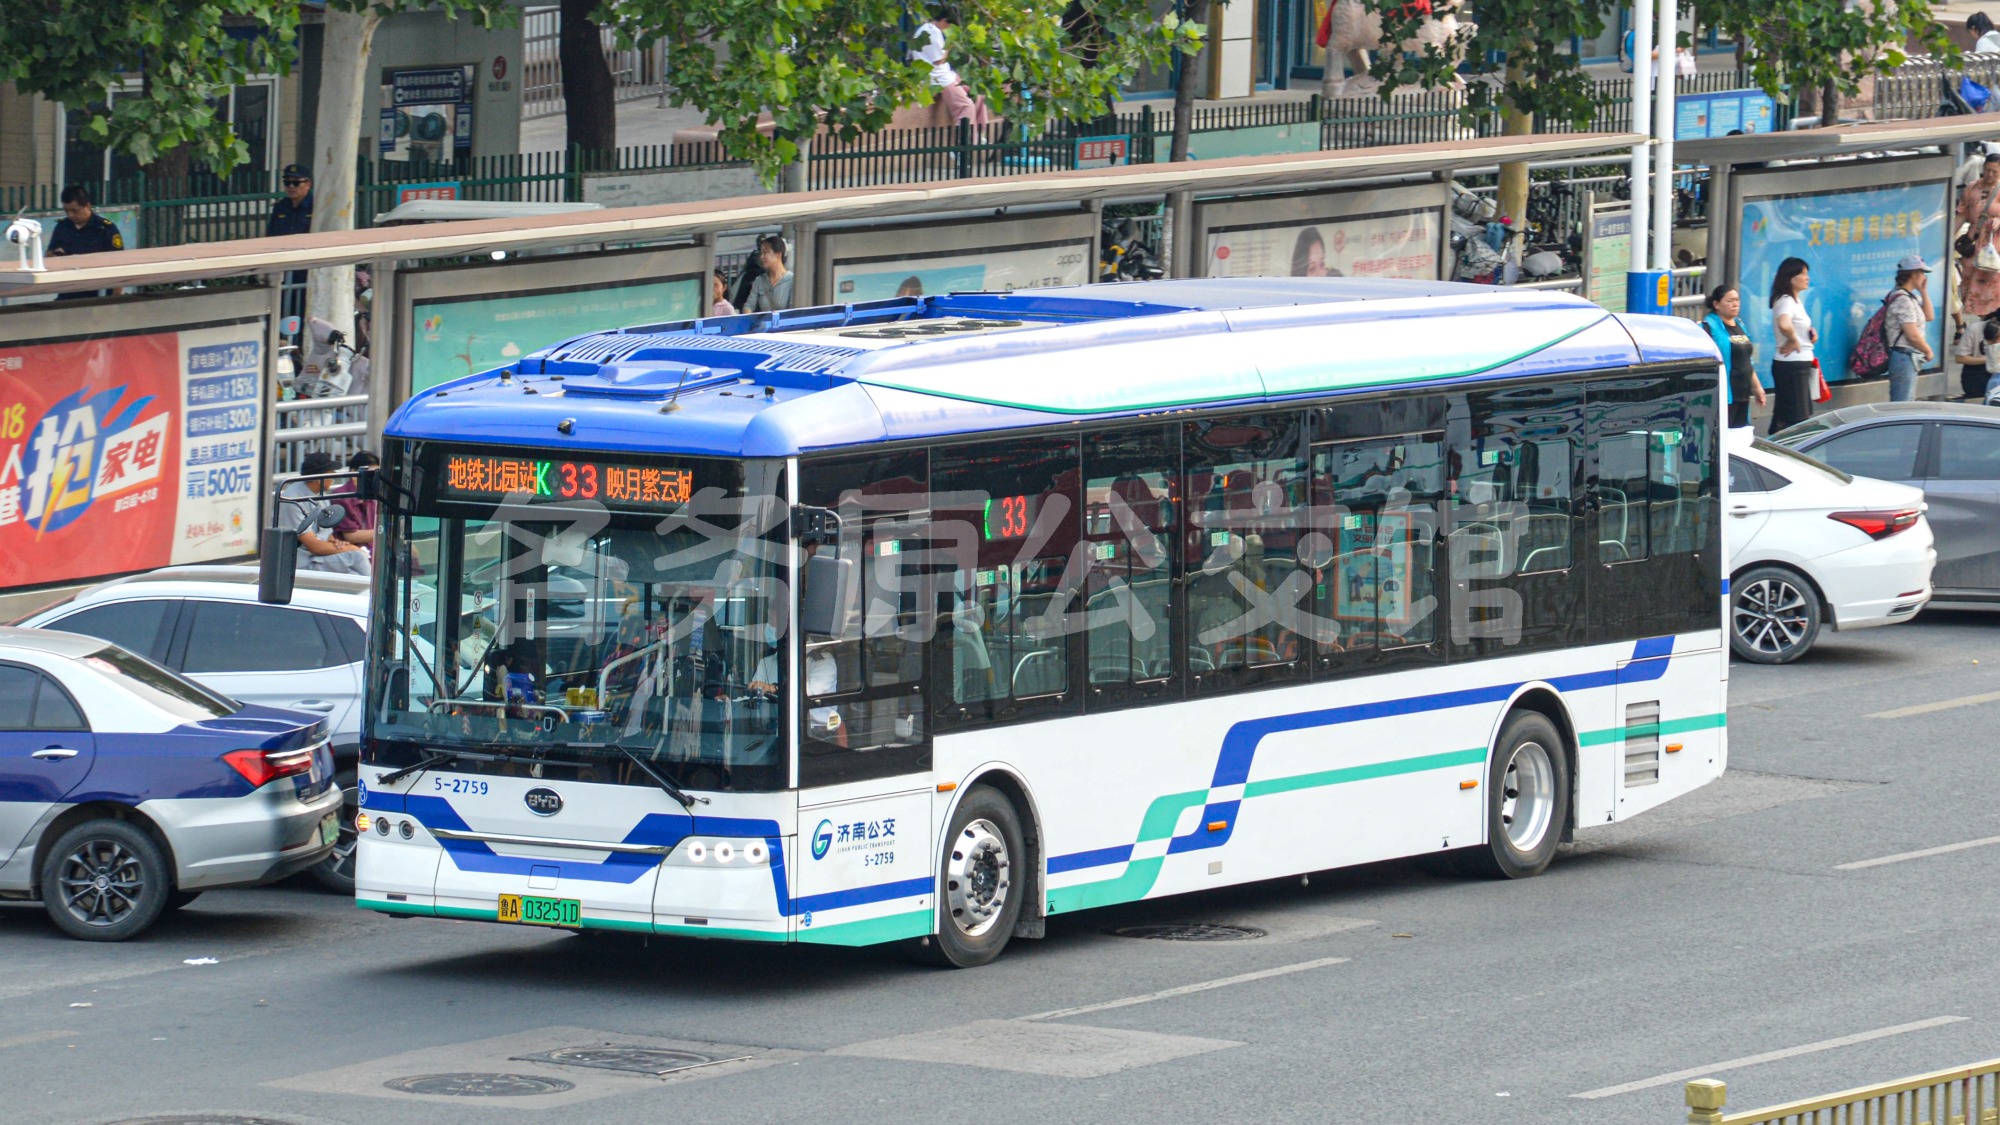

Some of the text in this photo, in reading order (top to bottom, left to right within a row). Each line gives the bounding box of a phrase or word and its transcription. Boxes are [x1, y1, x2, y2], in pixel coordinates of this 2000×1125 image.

[24, 405, 162, 522] 抢 家电
[448, 457, 537, 494] 地铁北园站
[606, 467, 693, 503] 映月紫云城
[435, 777, 489, 795] 5-2759
[528, 794, 560, 809] BYD
[837, 818, 896, 843] 济南公交
[836, 839, 895, 853] JINAN PUBLIC TRANSPORT
[864, 851, 894, 867] 5-2759
